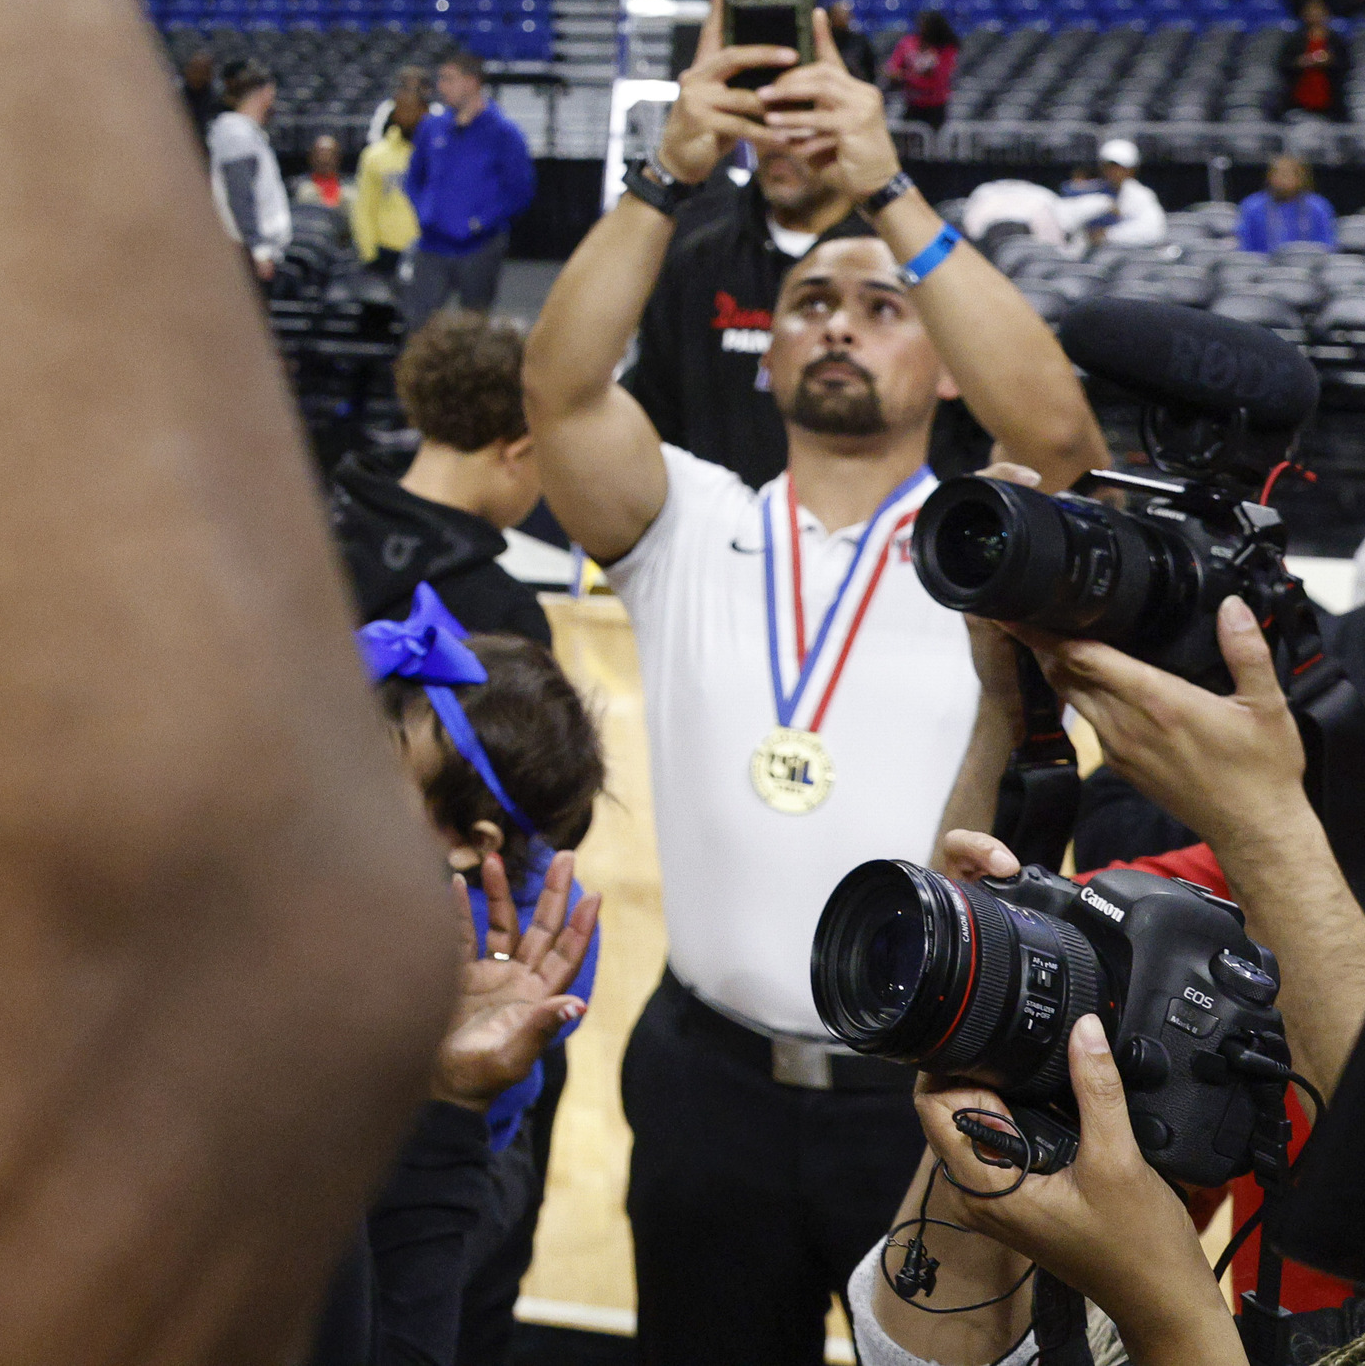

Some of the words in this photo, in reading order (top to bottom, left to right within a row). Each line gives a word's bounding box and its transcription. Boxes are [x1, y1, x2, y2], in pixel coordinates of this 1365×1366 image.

[1080, 886, 1125, 923] Canon
[958, 914, 970, 943] CANON
[1183, 986, 1215, 1009] EOS
